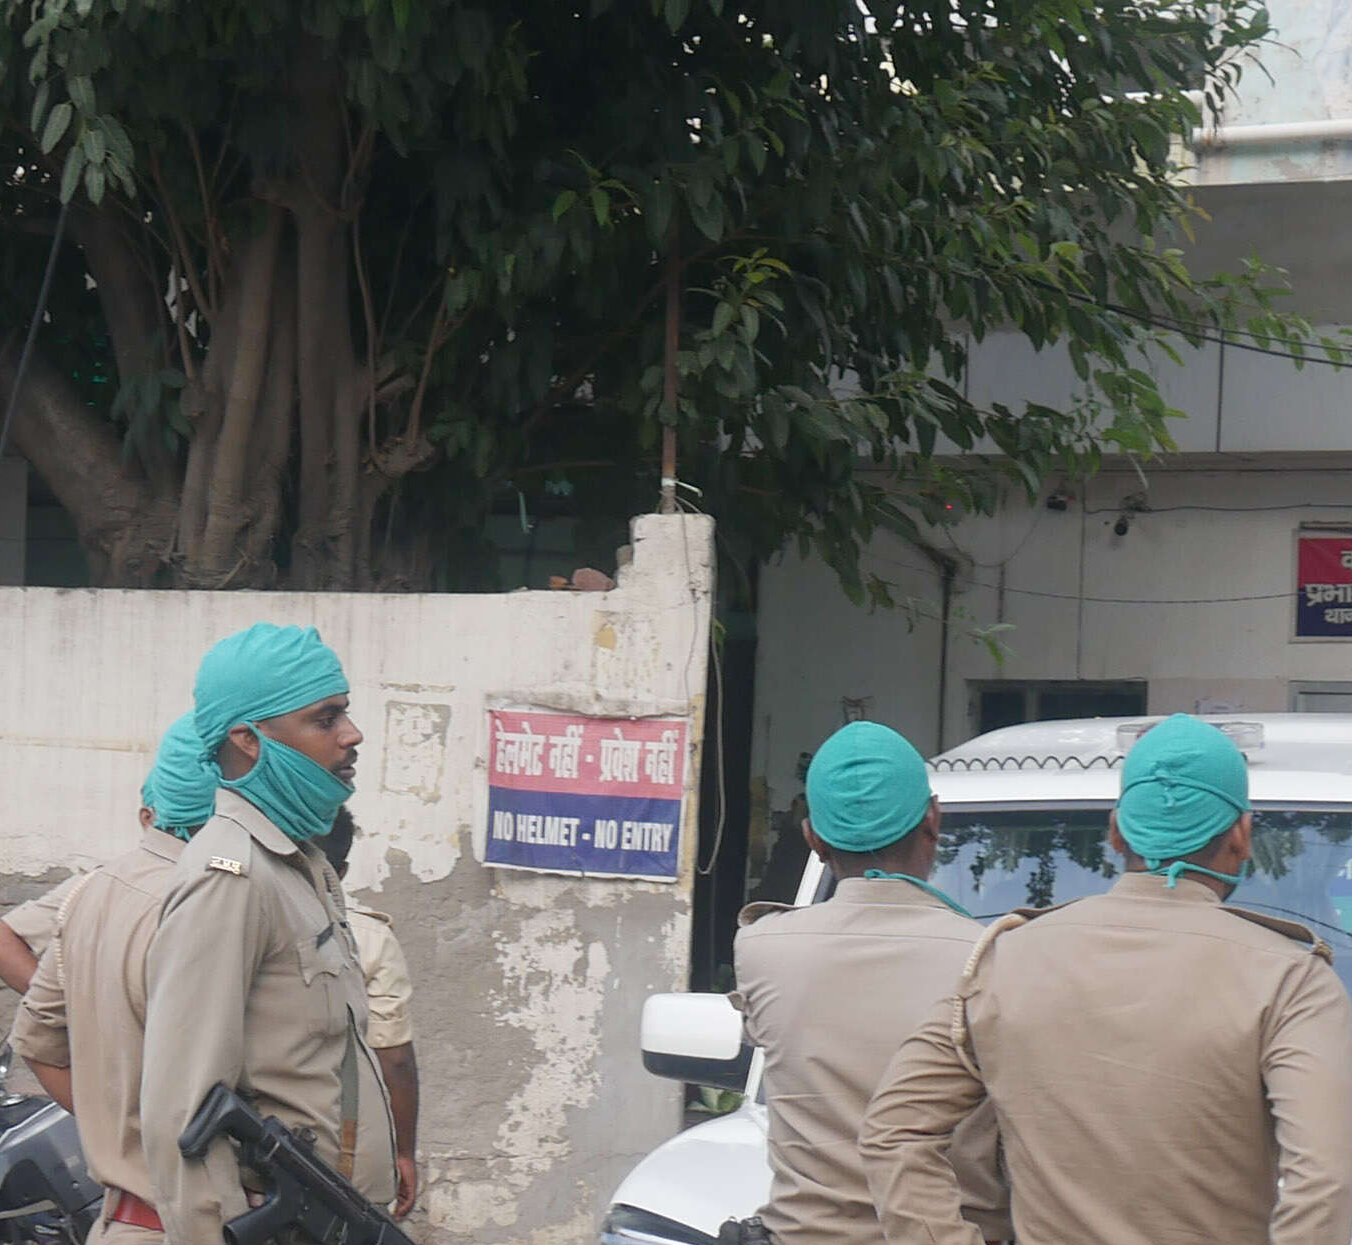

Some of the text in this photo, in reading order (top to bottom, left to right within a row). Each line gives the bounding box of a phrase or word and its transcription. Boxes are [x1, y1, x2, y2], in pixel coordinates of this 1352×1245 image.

[494, 718, 546, 777] हेलमेट
[548, 724, 585, 779] नहीं
[598, 728, 643, 783] प्रवेश
[644, 729, 680, 785] नहीं
[492, 810, 514, 841] NO
[516, 815, 581, 847] HELMET
[593, 818, 619, 850] NO
[620, 821, 675, 853] ENTRY
